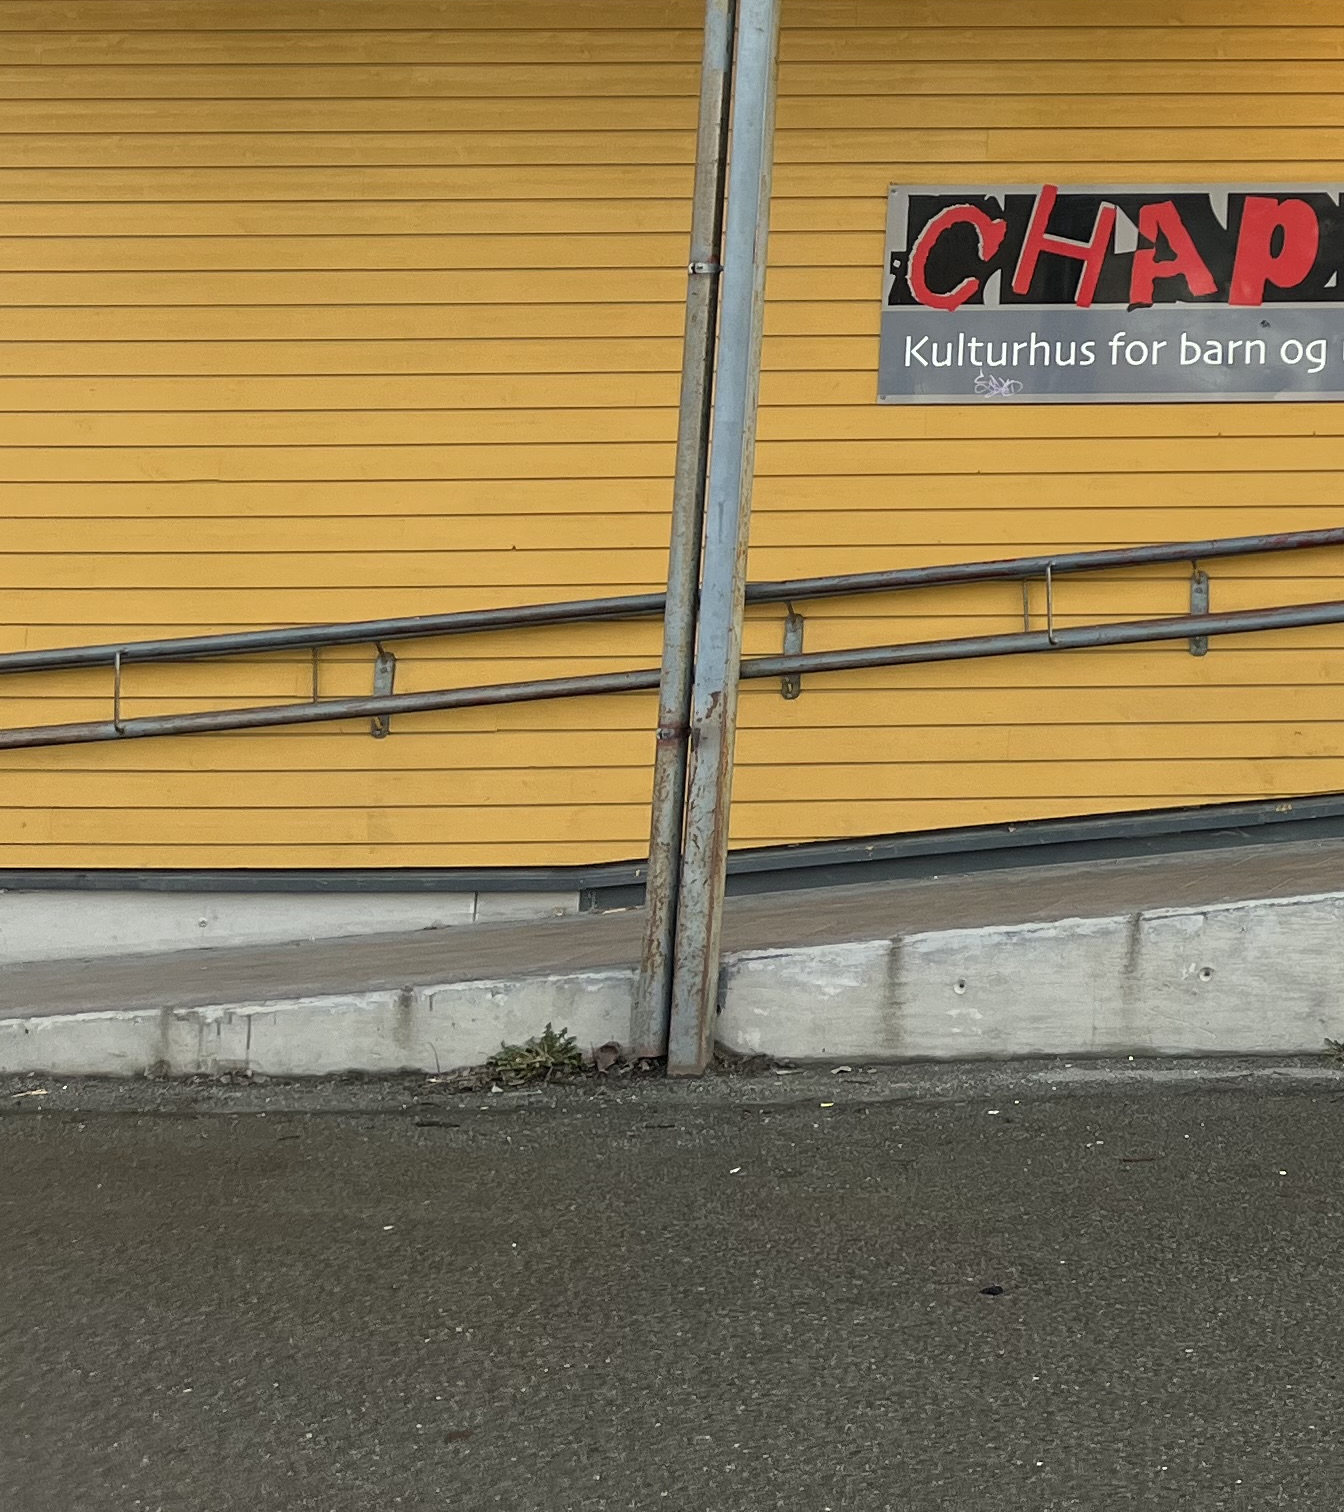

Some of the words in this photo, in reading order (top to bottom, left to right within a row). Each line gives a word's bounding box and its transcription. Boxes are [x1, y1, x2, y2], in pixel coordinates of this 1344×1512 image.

[904, 332, 1096, 368] Kulturhus
[1108, 331, 1168, 366] for
[1179, 332, 1266, 366] barn
[1279, 338, 1327, 374] og
